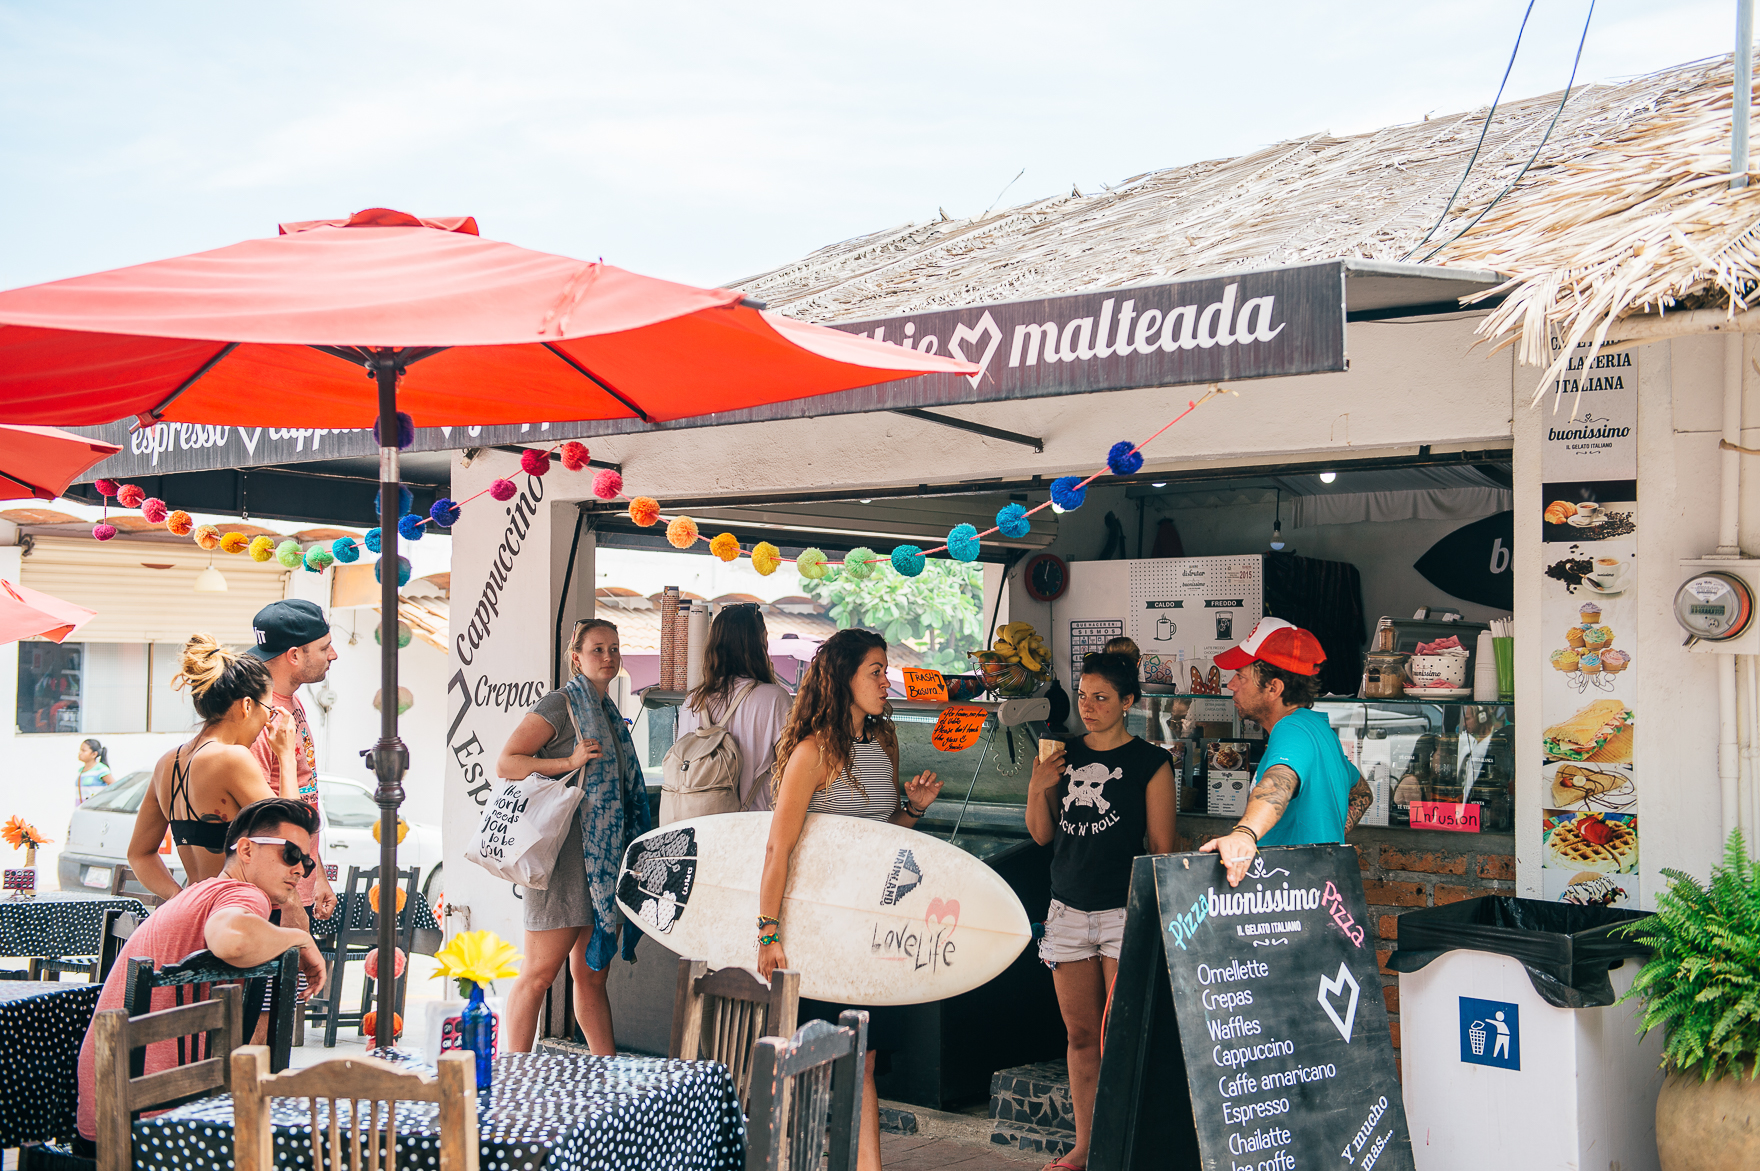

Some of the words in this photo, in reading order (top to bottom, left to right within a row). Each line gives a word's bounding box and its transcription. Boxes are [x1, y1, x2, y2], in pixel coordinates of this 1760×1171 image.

[1009, 283, 1286, 368] malteada
[131, 422, 230, 466] espresso
[1548, 424, 1631, 441] buonissimo
[456, 474, 543, 666] Cappuccino
[1240, 570, 1252, 579] 2015
[904, 672, 936, 682] TRASH
[474, 675, 544, 713] Crepas
[492, 810, 520, 824] needs
[494, 796, 530, 814] world
[1412, 806, 1478, 826] Infusion
[481, 814, 508, 834] you
[489, 832, 500, 842] to
[501, 835, 515, 846] be
[884, 849, 908, 904] MAINLAND
[1168, 894, 1209, 950] Pizza
[1208, 882, 1320, 917] buonissimo
[1321, 880, 1365, 948] Pizza
[1237, 925, 1245, 936] IL
[1245, 922, 1270, 936] GELATO
[1271, 920, 1302, 934] ITALIANO
[1197, 960, 1269, 986] Omellette
[1202, 988, 1253, 1012] Crepas
[1207, 1016, 1262, 1042] Waffles
[1212, 1038, 1294, 1070] Cappuccino
[1218, 1072, 1258, 1098] Caffe
[1261, 1063, 1336, 1090] amaricano
[1222, 1098, 1290, 1126] Espresso
[1228, 1126, 1292, 1156] Chailatte
[1340, 1144, 1356, 1165] Y
[1352, 1095, 1389, 1152] mucho
[1258, 1150, 1296, 1171] coffe
